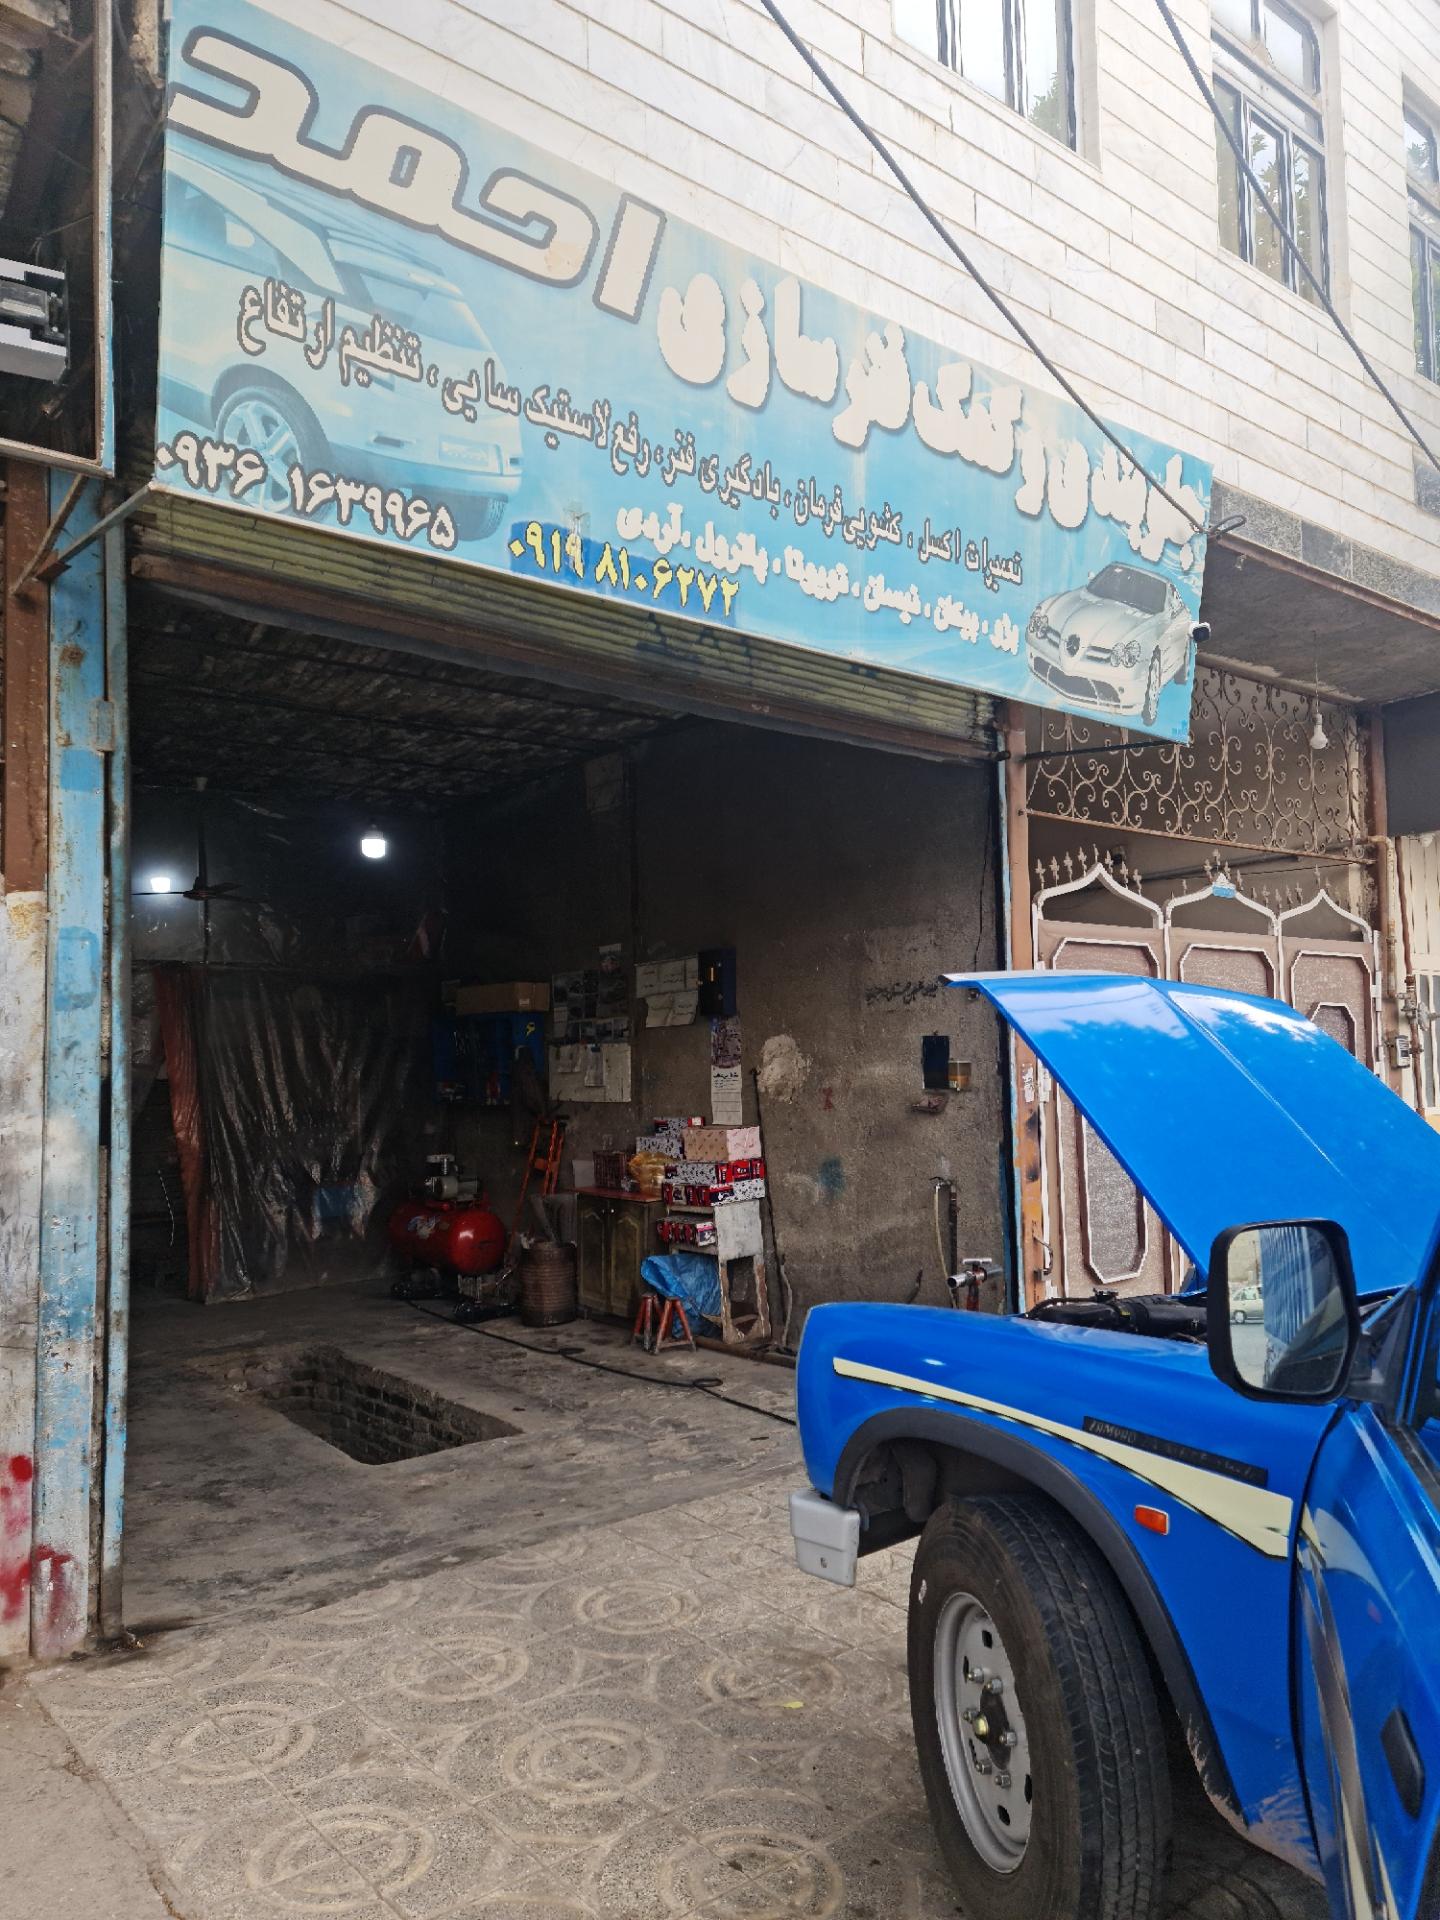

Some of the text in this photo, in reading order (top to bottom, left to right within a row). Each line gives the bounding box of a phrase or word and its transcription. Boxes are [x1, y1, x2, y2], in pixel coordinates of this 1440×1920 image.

[166, 24, 667, 324] احمد
[236, 276, 336, 371] ارتفاع
[339, 313, 422, 389] تنظیم
[657, 271, 841, 412] سازی
[523, 385, 612, 450] لاستیک
[610, 410, 651, 478] رفع
[154, 428, 458, 552] ۰۹۳۶ ۱۶۳۹۹۶۵
[841, 502, 903, 551] کشویی
[507, 519, 741, 618] ۰۹۱۹ ۸۱۰۶۲۷۲
[964, 536, 1024, 594] تعمیرات
